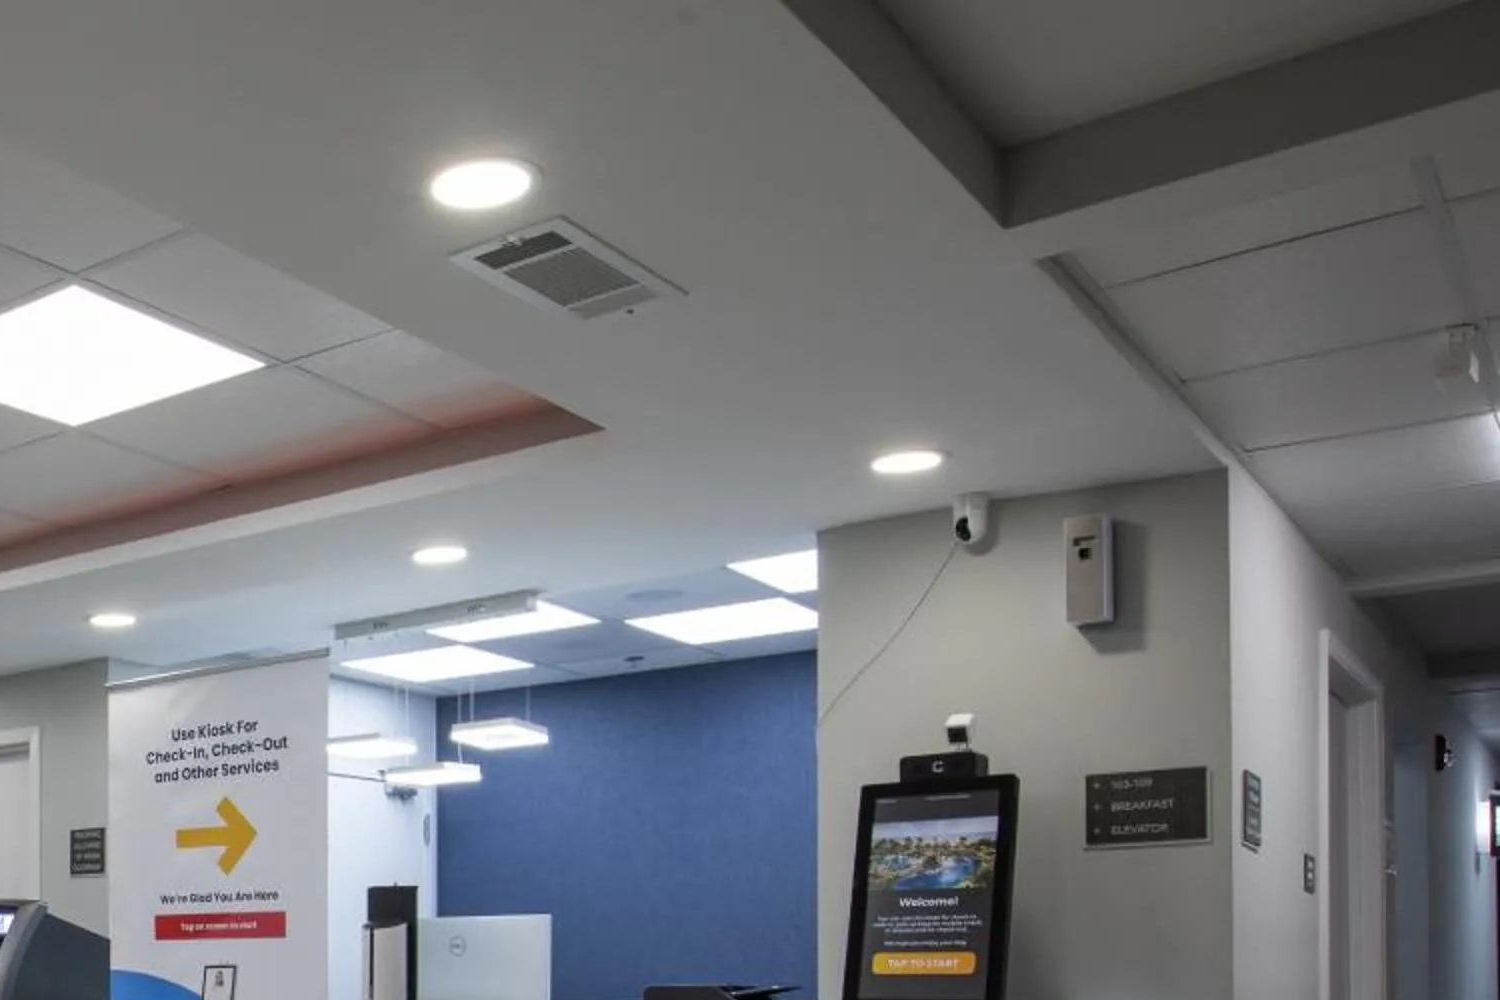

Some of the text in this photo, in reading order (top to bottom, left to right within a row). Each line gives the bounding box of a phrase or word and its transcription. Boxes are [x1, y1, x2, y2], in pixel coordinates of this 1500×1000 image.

[171, 719, 259, 742] Use Kiosk For
[146, 736, 288, 765] Check-In, Check-Out
[154, 758, 279, 783] and Other Services
[1111, 799, 1173, 812] BREAKFAST
[1111, 823, 1168, 835] ELEVATOR
[160, 889, 280, 905] We're Glad You Are Here
[899, 895, 960, 908] Welcome!
